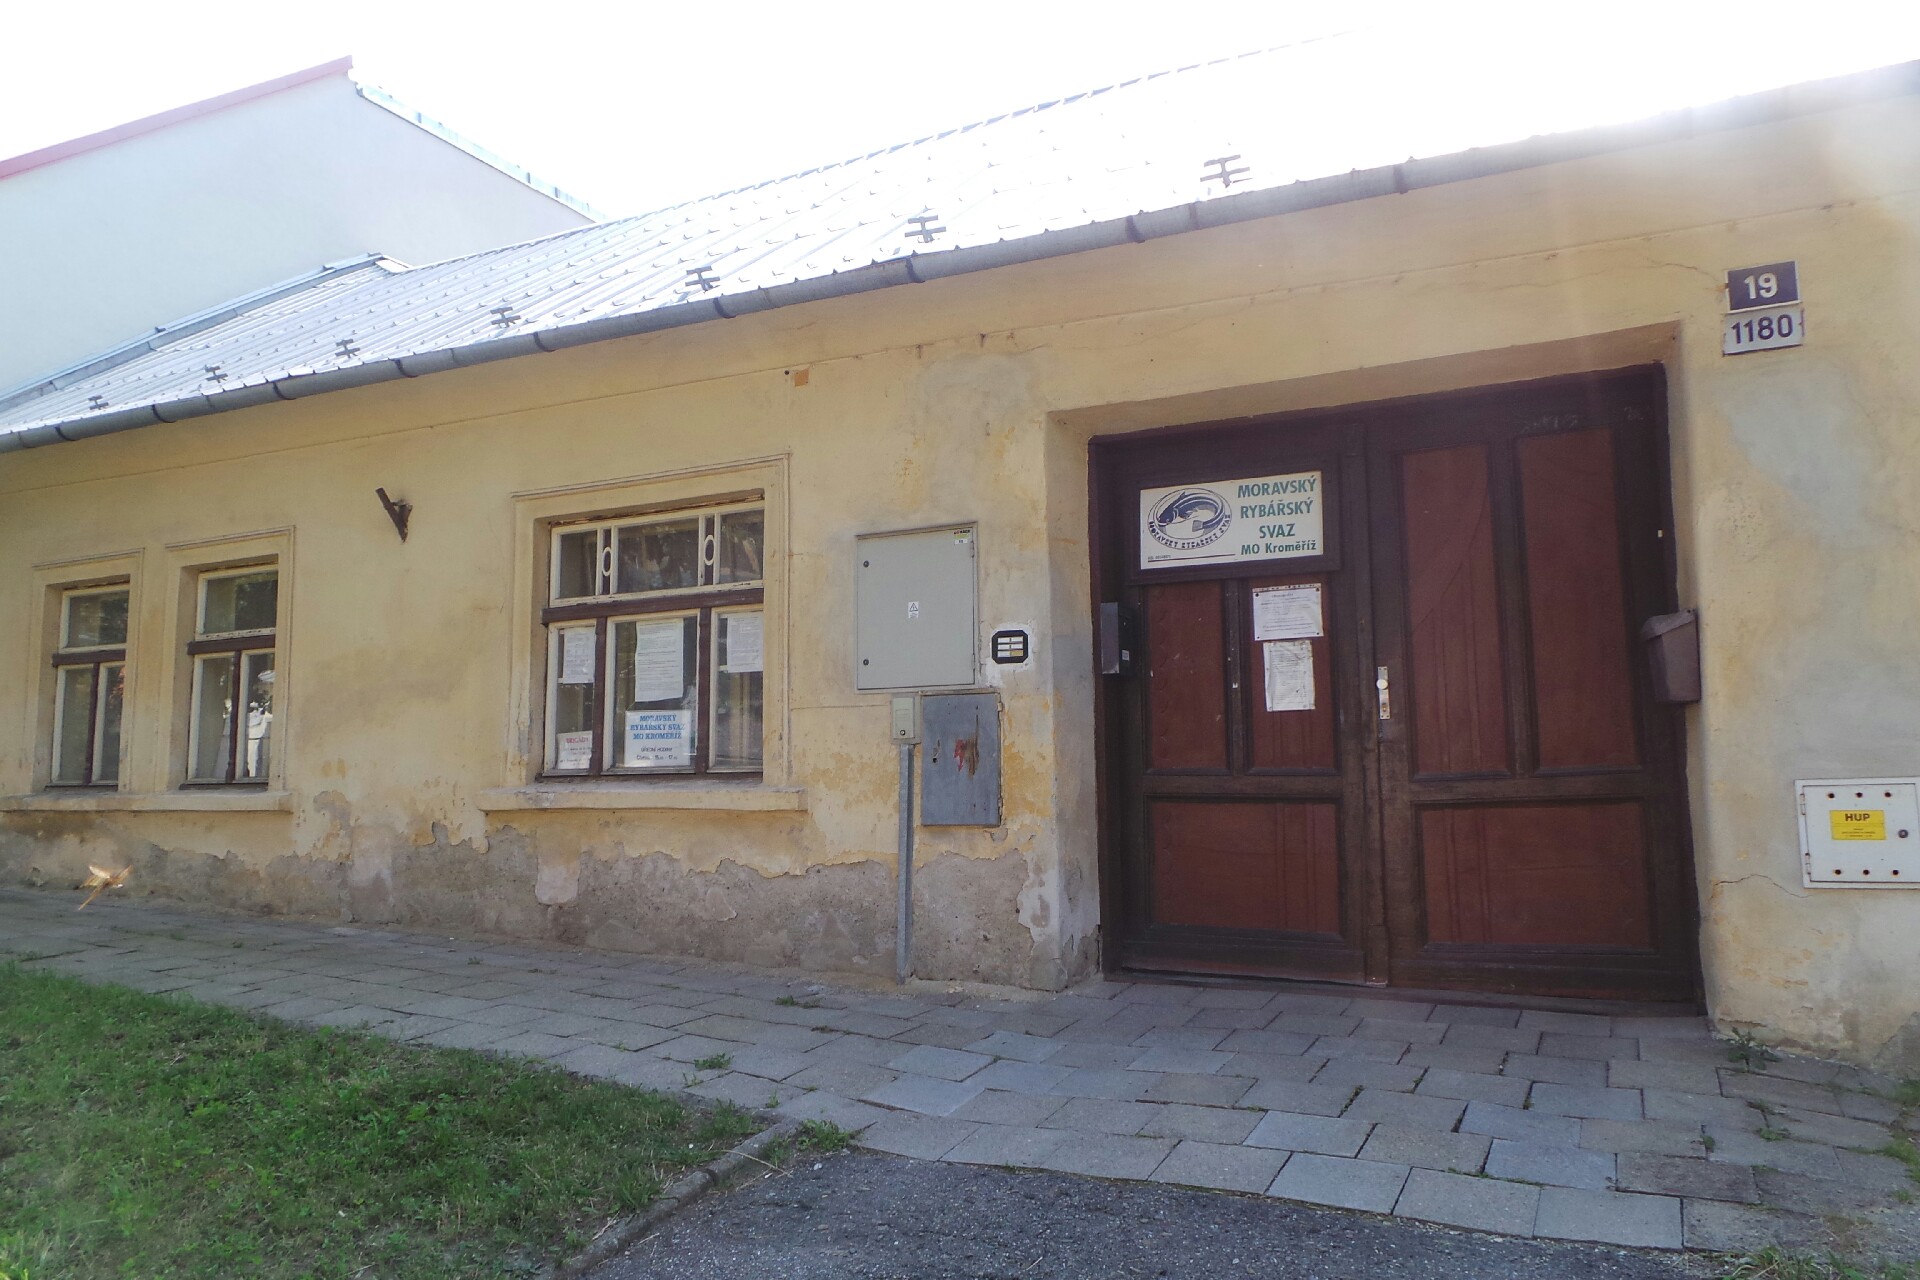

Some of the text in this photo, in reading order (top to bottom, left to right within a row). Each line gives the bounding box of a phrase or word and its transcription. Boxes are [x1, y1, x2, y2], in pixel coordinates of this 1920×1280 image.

[1744, 272, 1778, 299] 19
[1731, 314, 1793, 344] 1180
[1237, 475, 1317, 498] MORAVSKÝ
[1240, 497, 1314, 519] RYBÁŘSKÝ
[1259, 523, 1296, 539] SVAZ
[1241, 539, 1317, 556] MO Kroměříž
[1845, 813, 1870, 822] HUP
